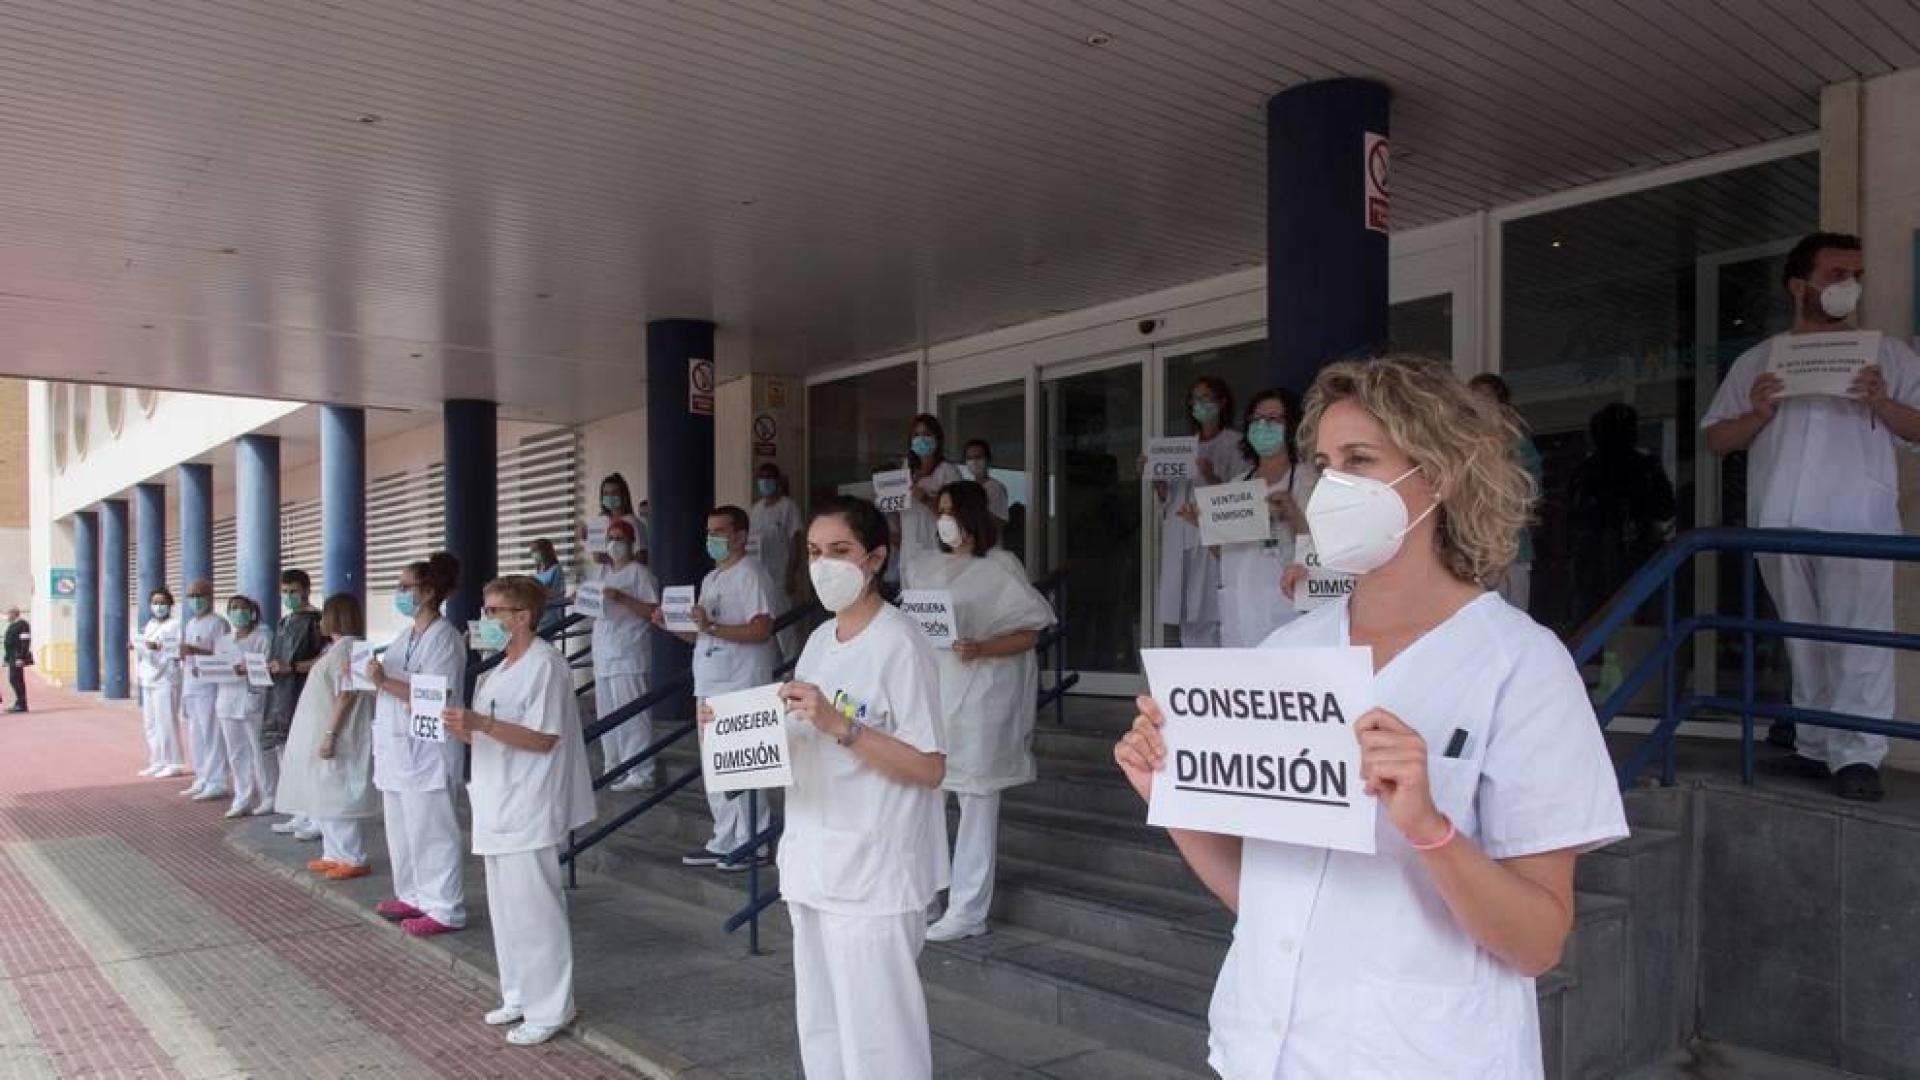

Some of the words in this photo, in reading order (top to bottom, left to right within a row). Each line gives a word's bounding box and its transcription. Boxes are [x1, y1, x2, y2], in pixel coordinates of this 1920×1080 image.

[1153, 462, 1188, 476] CESE
[1209, 492, 1254, 505] VENTURA
[1308, 579, 1353, 594] DIMIS
[902, 602, 947, 614] ONSEJERA
[1169, 687, 1345, 724] CONSEJERA
[413, 714, 439, 739] CESE
[715, 709, 779, 736] CONSEJERA
[713, 741, 781, 771] DIMISIÓN
[1175, 748, 1348, 798] DIMISIÓN
